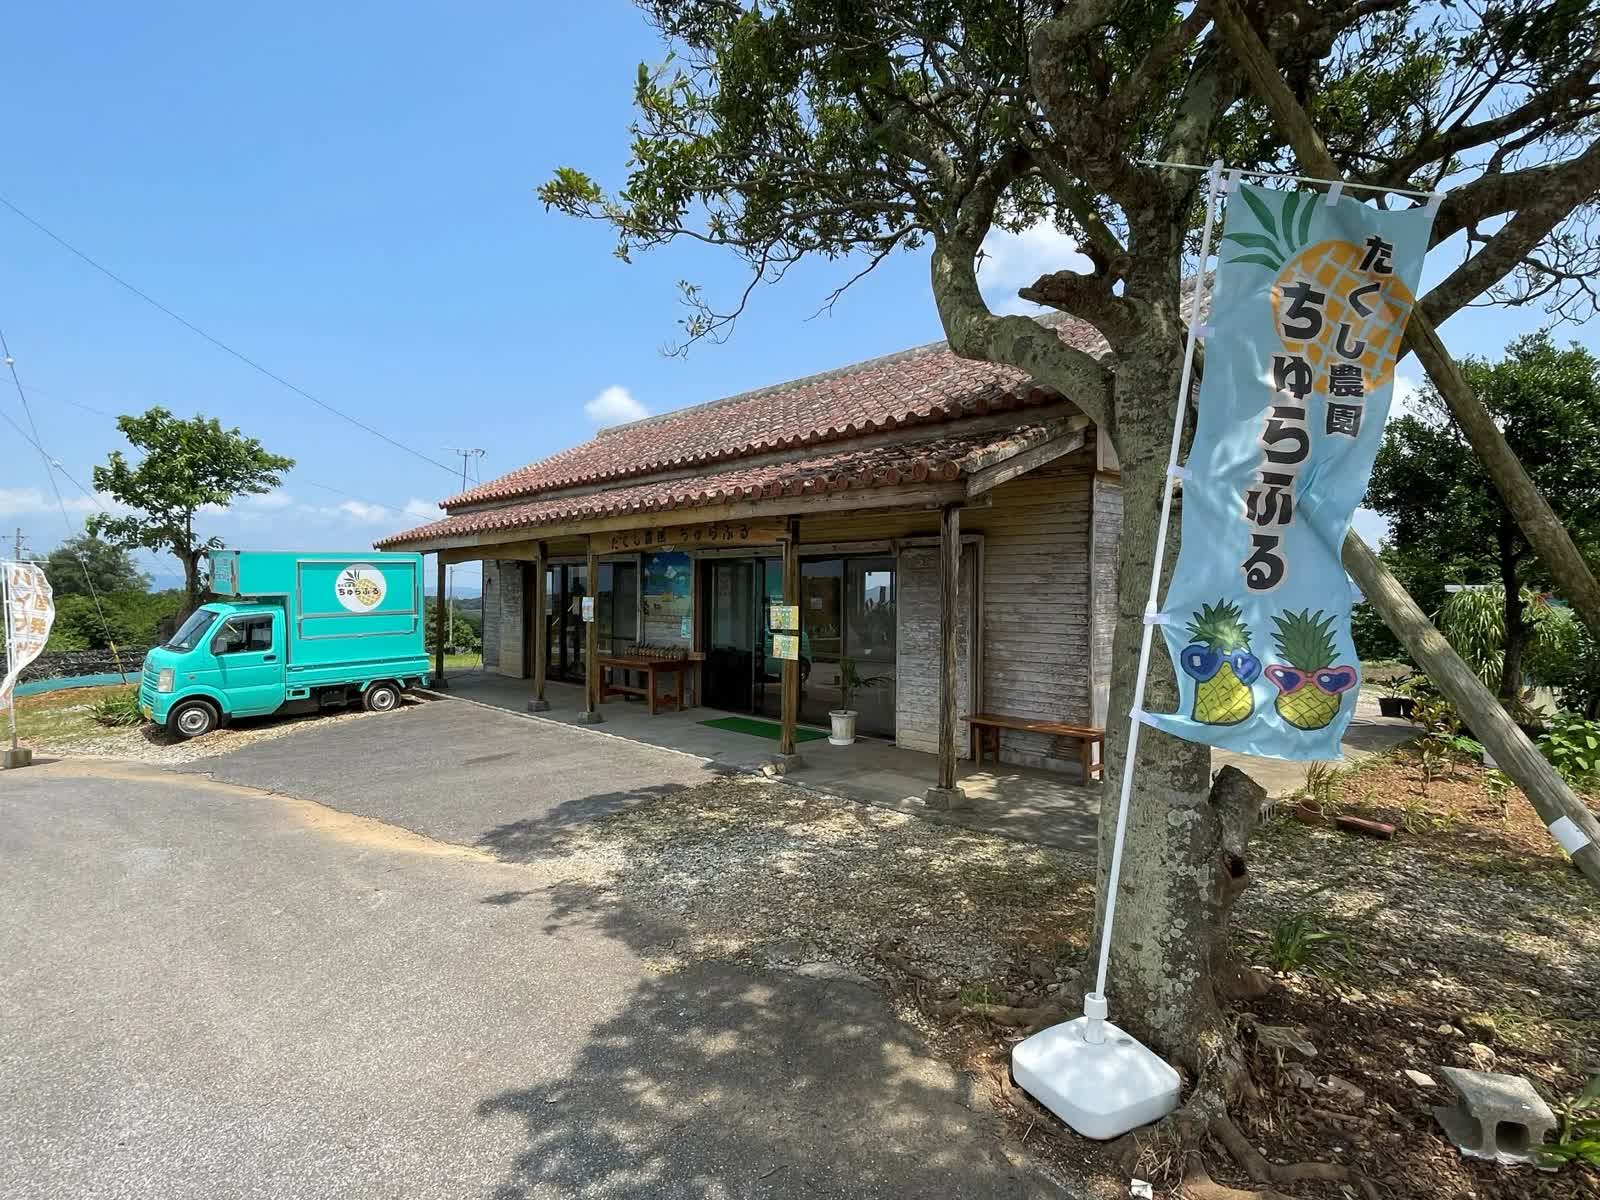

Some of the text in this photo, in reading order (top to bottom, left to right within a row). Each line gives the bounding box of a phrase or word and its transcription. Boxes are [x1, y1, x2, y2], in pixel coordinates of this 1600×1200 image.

[1240, 281, 1326, 592] ちゅらふる
[1325, 234, 1394, 438] たくし農園
